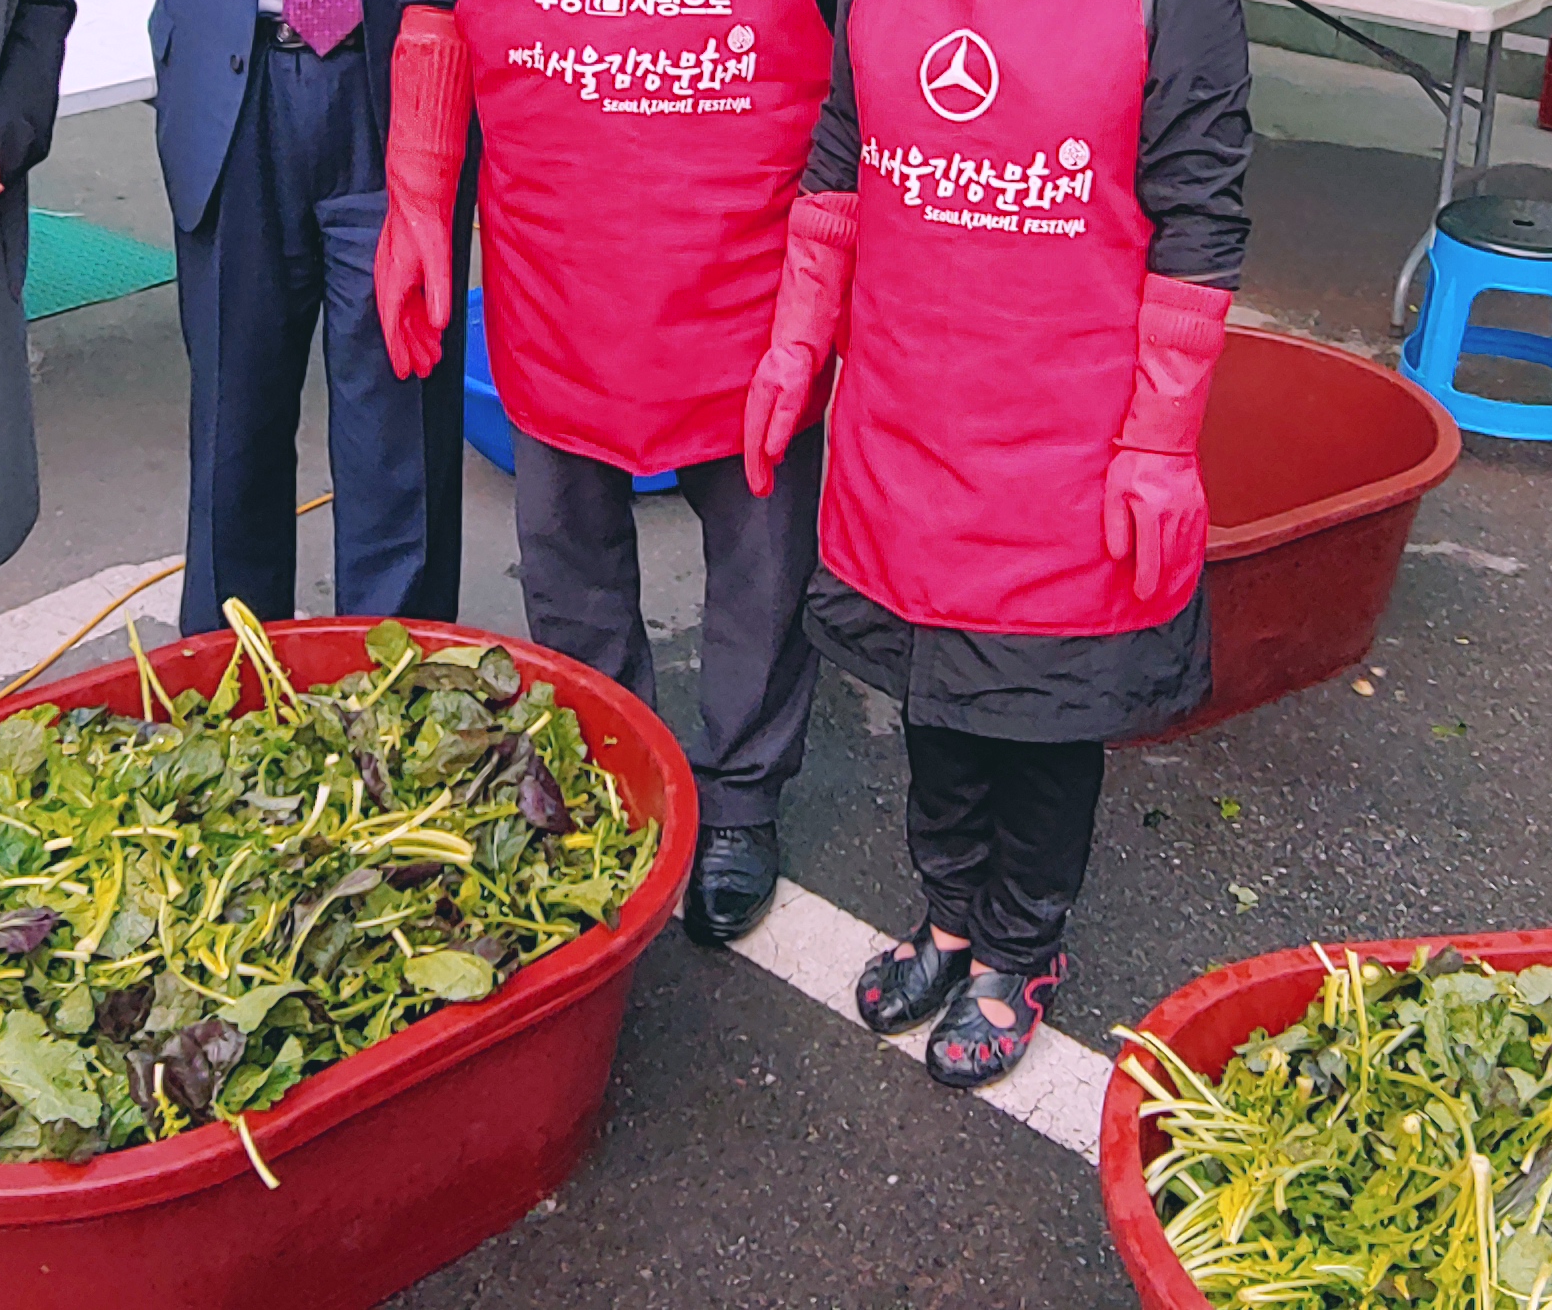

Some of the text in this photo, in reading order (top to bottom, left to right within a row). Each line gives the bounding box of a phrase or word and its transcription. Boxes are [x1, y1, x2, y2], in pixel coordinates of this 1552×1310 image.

[546, 37, 756, 101] 서울김장문화제
[698, 96, 751, 115] FESTIVAL
[880, 144, 1093, 212] 서울김장문화제
[1023, 216, 1086, 239] FESTIVAL
